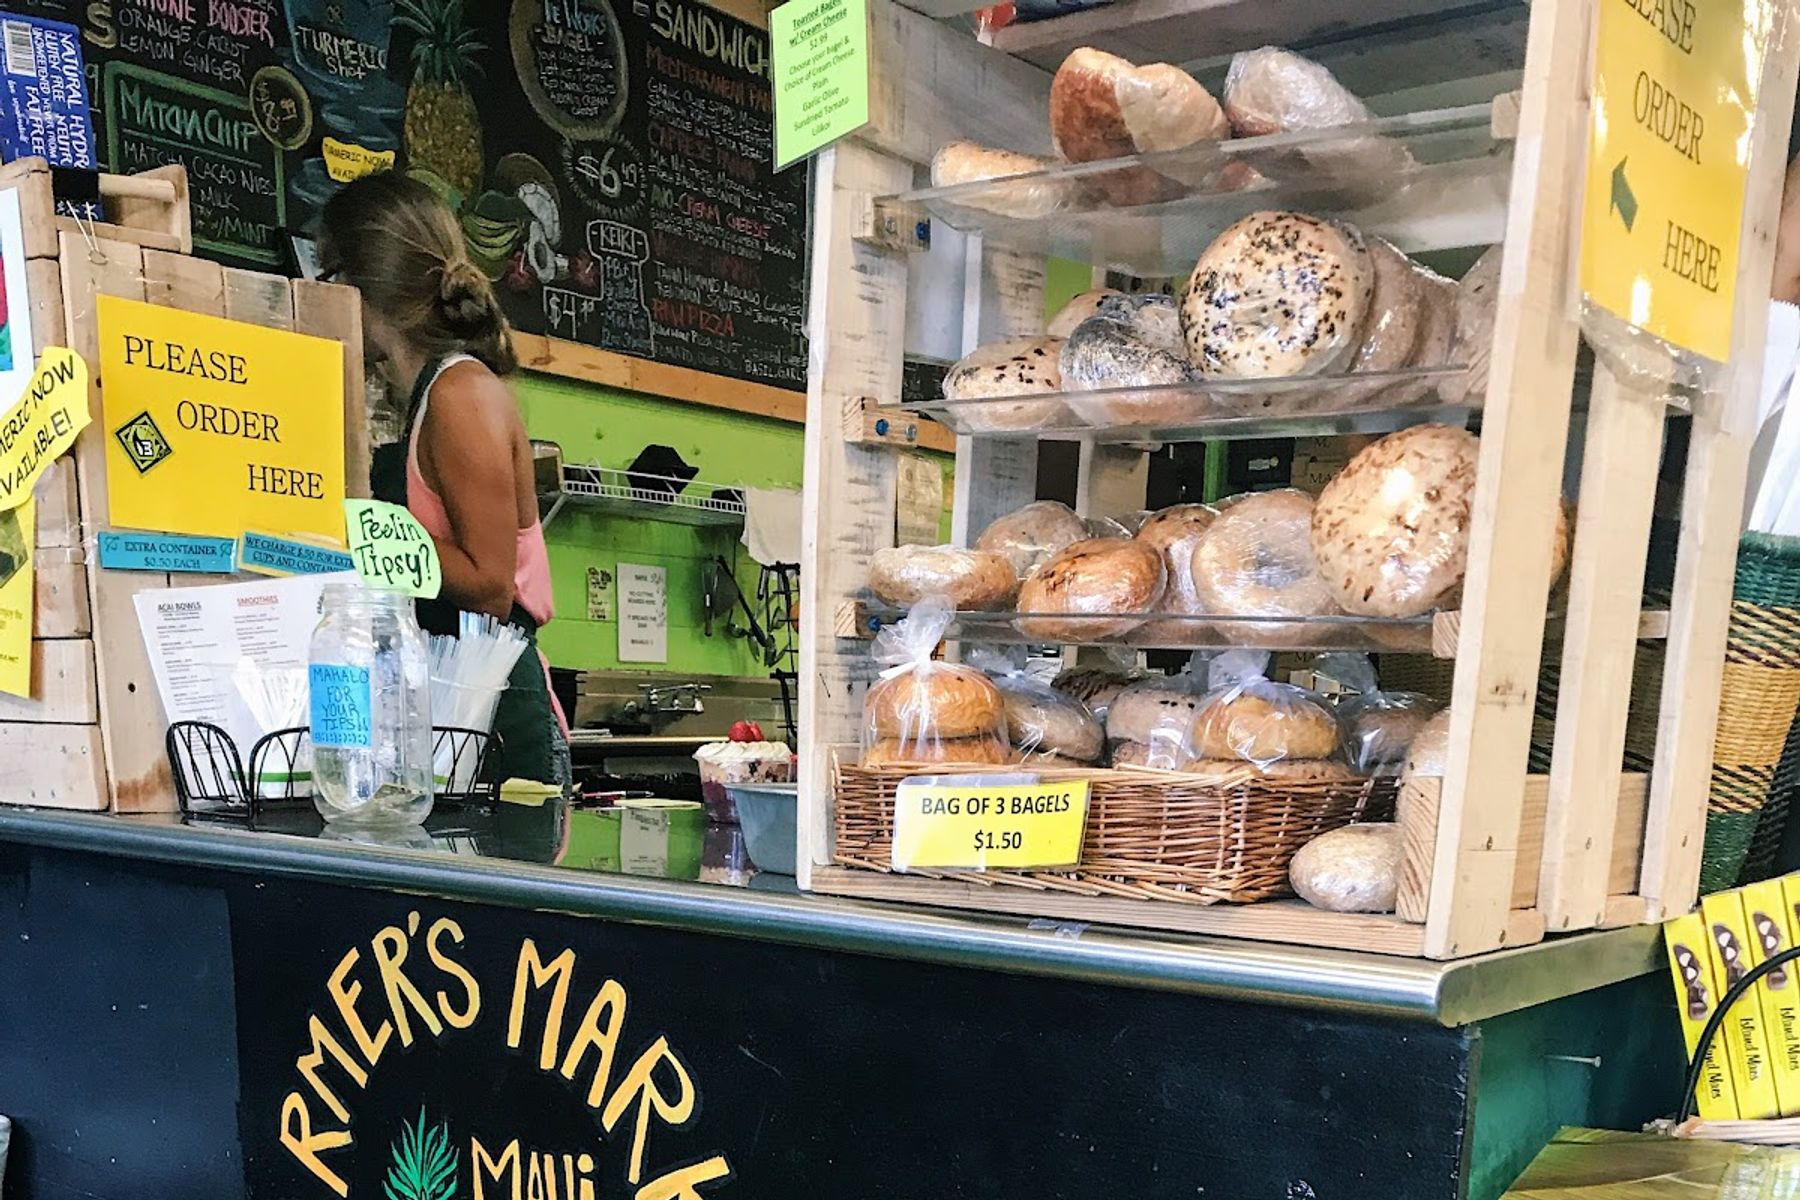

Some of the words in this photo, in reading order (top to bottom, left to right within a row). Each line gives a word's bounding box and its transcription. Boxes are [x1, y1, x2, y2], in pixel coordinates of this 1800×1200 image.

[800, 22, 822, 41] Cream
[823, 8, 848, 27] Cheese
[119, 31, 175, 60] LEMON
[297, 26, 388, 70] TURMERIC
[59, 31, 83, 110] NATURAL
[325, 56, 368, 80] Shot
[783, 76, 804, 93] Choice
[811, 61, 832, 77] Cream
[832, 47, 855, 68] Cheese
[788, 57, 811, 76] Choose
[811, 76, 829, 91] Plain
[26, 86, 41, 116] FAT
[802, 96, 820, 112] Garlic
[821, 86, 840, 102] Olive
[823, 96, 850, 115] Tomato
[1633, 70, 1705, 165] ORDER
[28, 117, 46, 156] FREE
[192, 155, 237, 185] CACAO
[1662, 219, 1722, 294] HERE
[123, 334, 249, 386] PLEASE
[31, 354, 74, 409] NOW
[176, 399, 282, 444] ORDER
[0, 406, 74, 499] VAILABLE!
[246, 463, 324, 500] HERE
[359, 507, 422, 542] Feelin
[124, 540, 158, 554] EXTRA
[161, 541, 217, 556] CONTAINER
[276, 555, 298, 568] AND
[173, 558, 202, 569] EACH
[354, 542, 431, 588] Tipsy?
[313, 668, 370, 684] MAHALO
[327, 686, 354, 703] FOR
[322, 703, 361, 720] YOUR
[921, 797, 960, 815] BAG
[966, 797, 990, 815] OF
[995, 796, 1005, 815] 3
[1010, 793, 1070, 815] BAGELS
[973, 829, 1022, 851] $1.50
